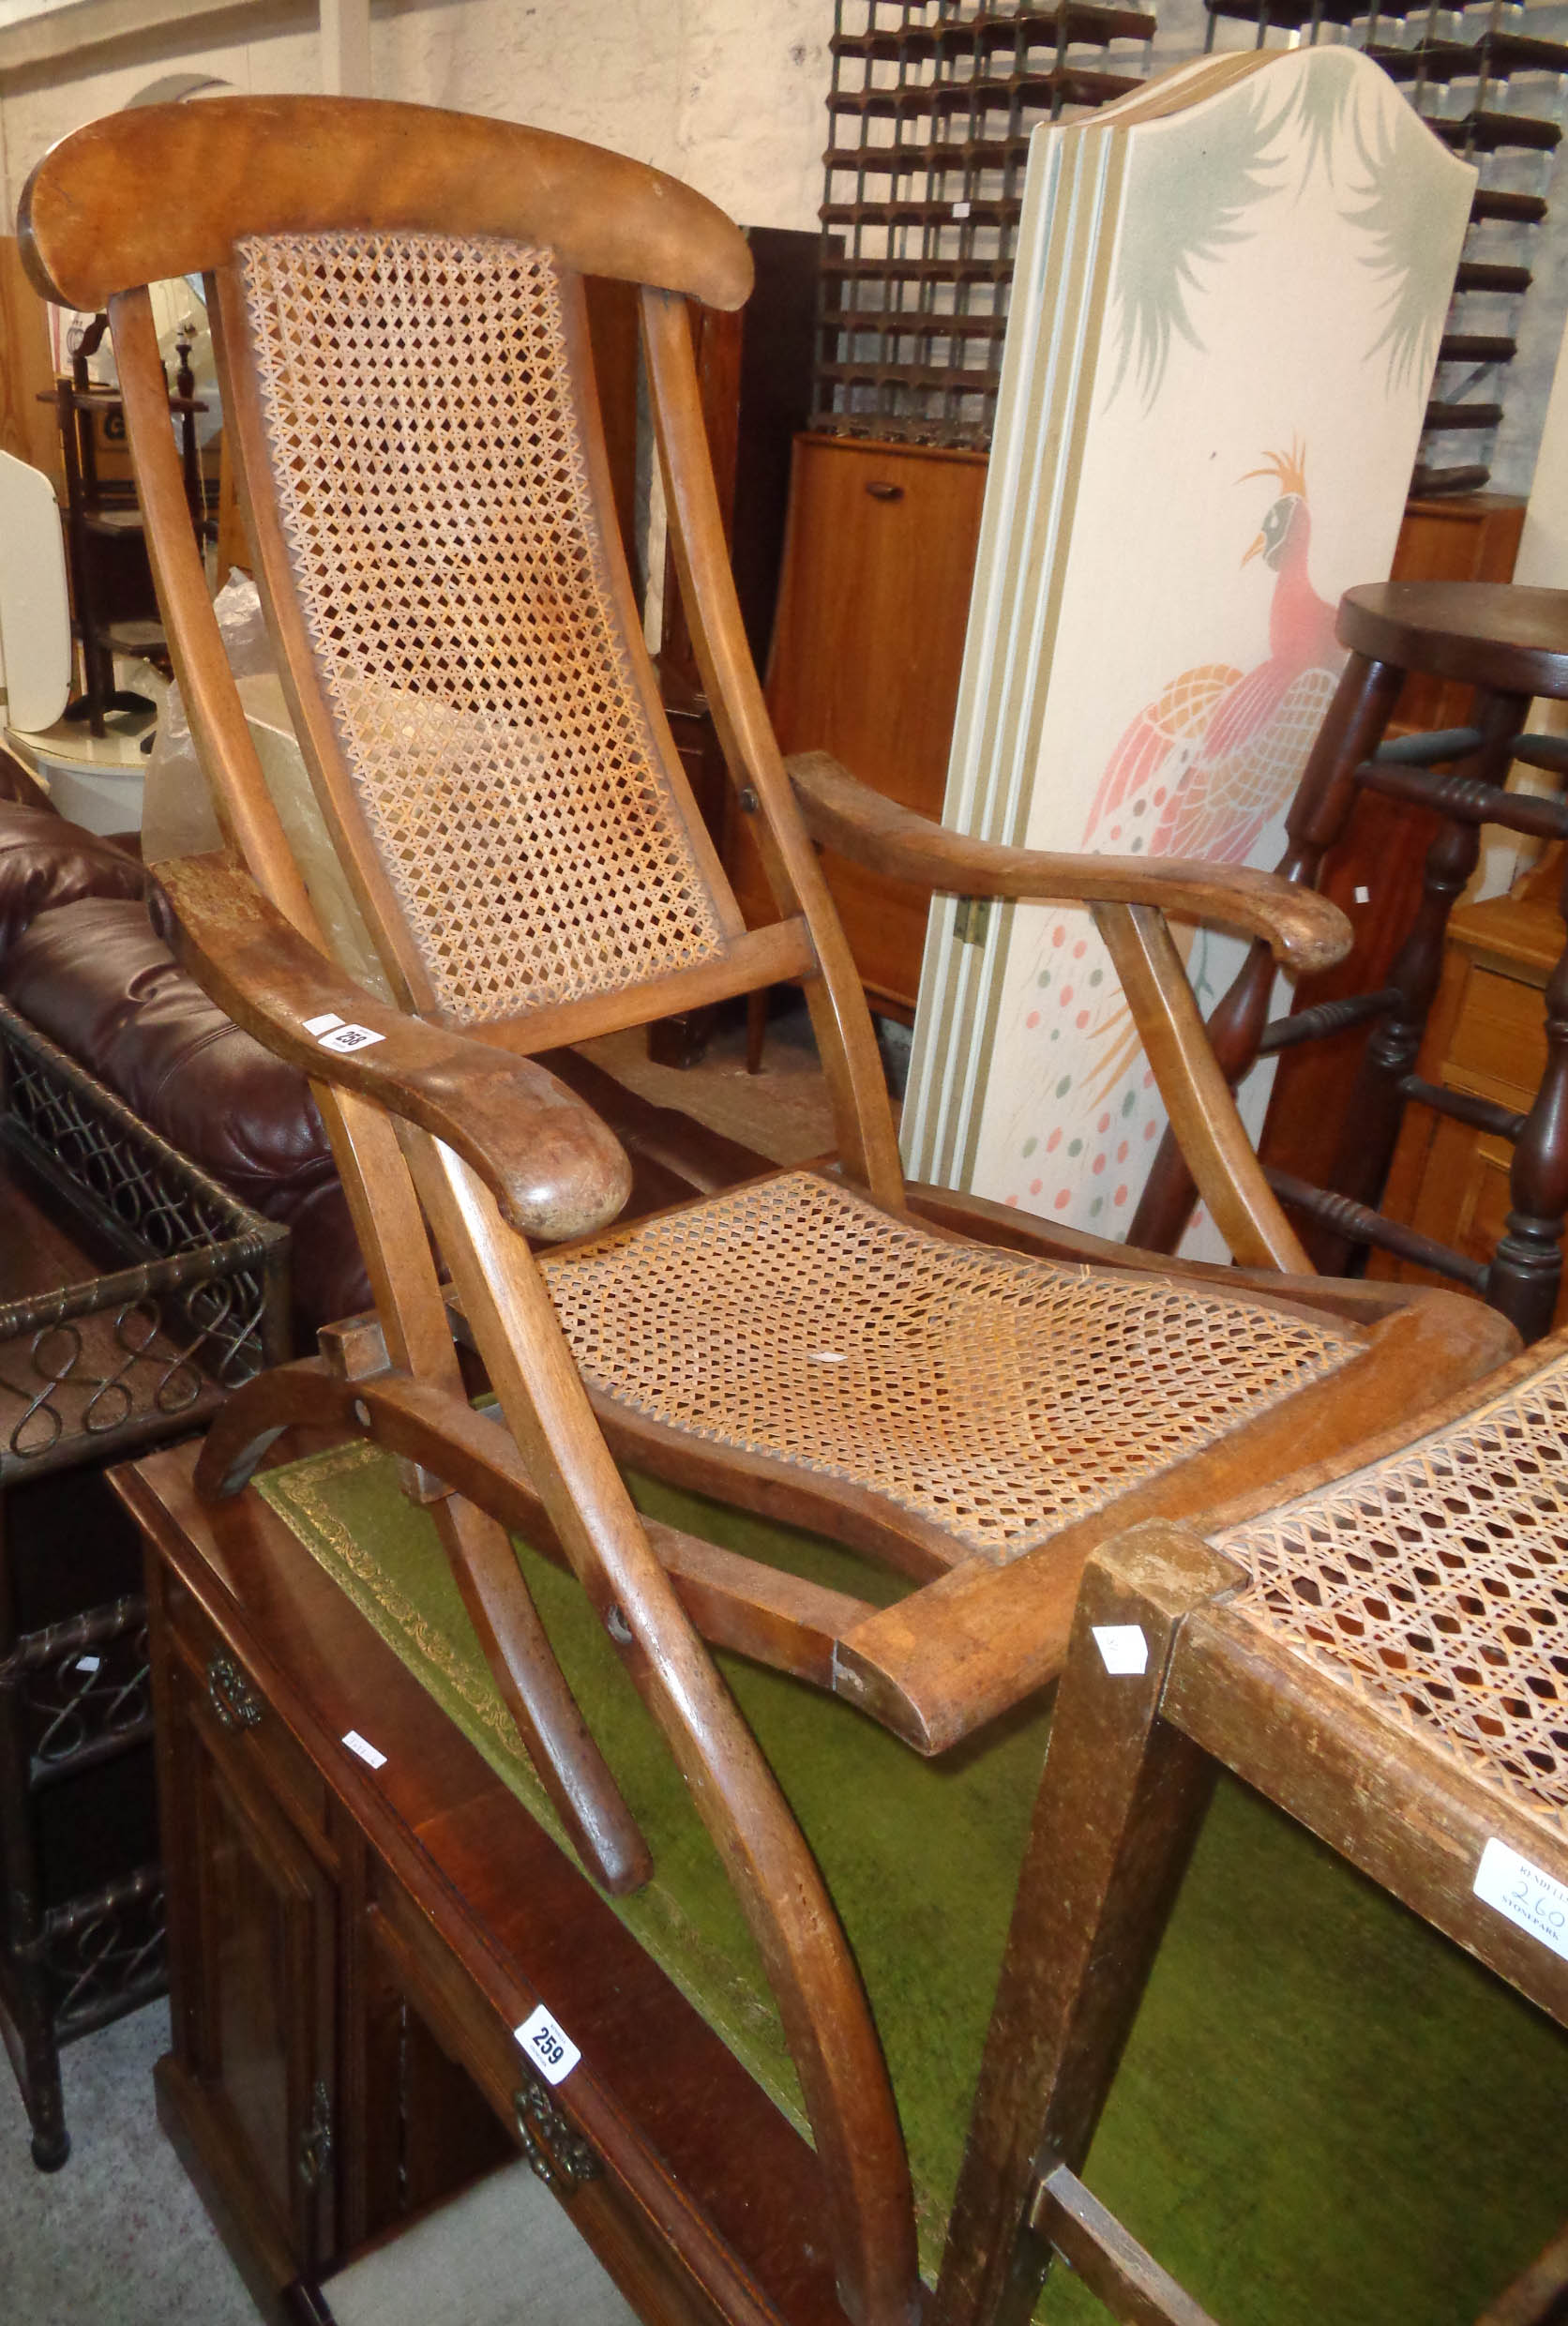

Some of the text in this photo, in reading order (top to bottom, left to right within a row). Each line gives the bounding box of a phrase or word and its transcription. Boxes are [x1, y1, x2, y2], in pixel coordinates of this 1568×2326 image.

[335, 1031, 368, 1046] 258
[1511, 1880, 1564, 1927] 260
[1520, 1865, 1568, 1904] RENDELL
[1502, 1895, 1559, 1941] STONEPARK
[532, 2026, 565, 2065] 259
